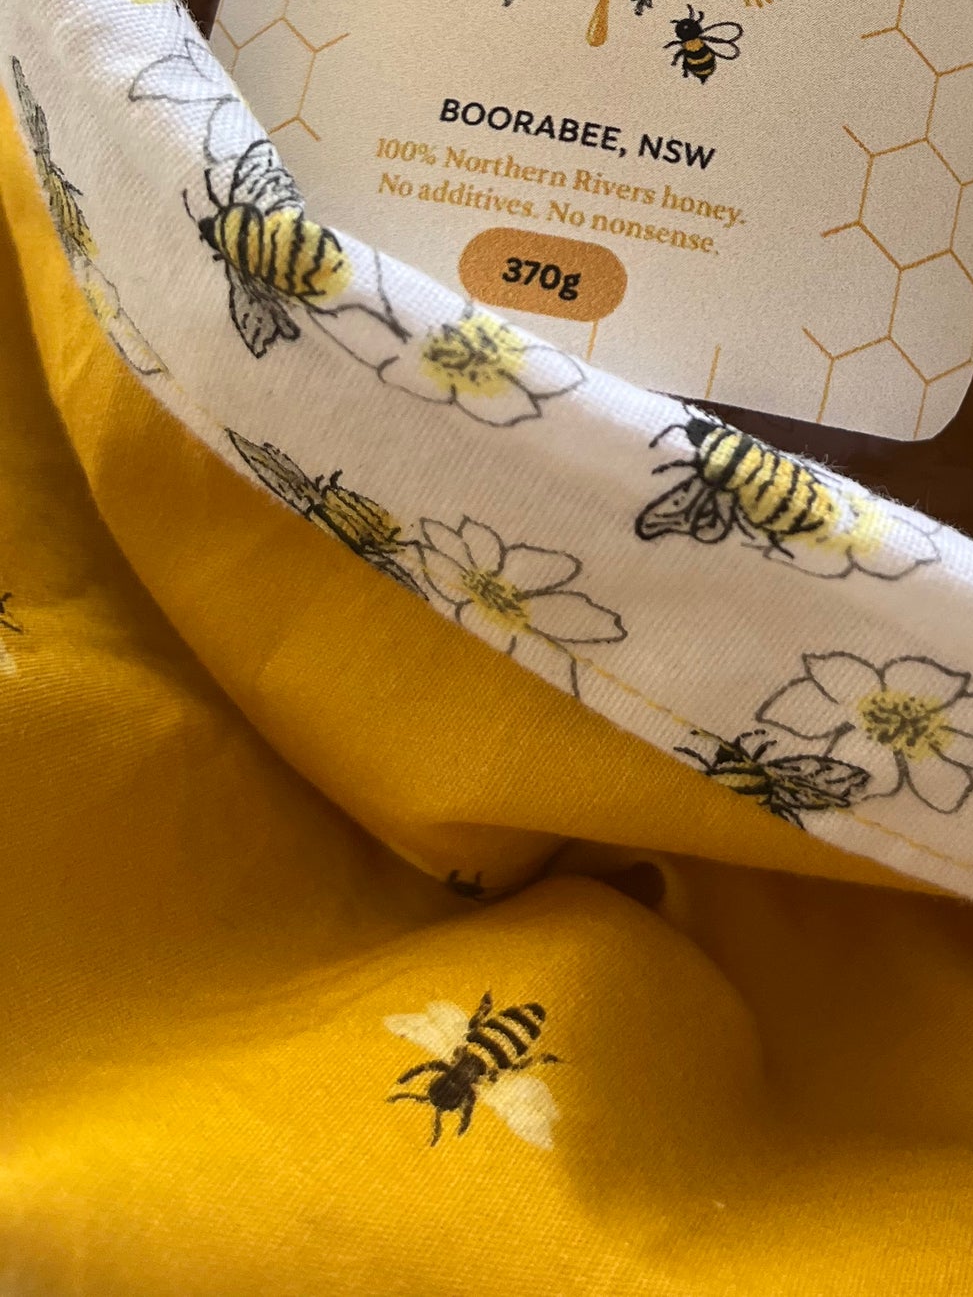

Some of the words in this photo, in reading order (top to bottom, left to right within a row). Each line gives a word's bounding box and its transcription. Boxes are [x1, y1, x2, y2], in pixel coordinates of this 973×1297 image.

[440, 98, 628, 158] BOORABEE,
[638, 133, 716, 170] NSW
[376, 137, 437, 166] 100%
[442, 145, 567, 188] Northern
[573, 169, 656, 205] Rivers
[661, 184, 746, 228] honey.
[378, 172, 413, 198] No
[418, 179, 538, 219] additives.
[546, 200, 586, 227] No
[590, 213, 720, 255] nonsense.
[501, 256, 582, 301] 370g
